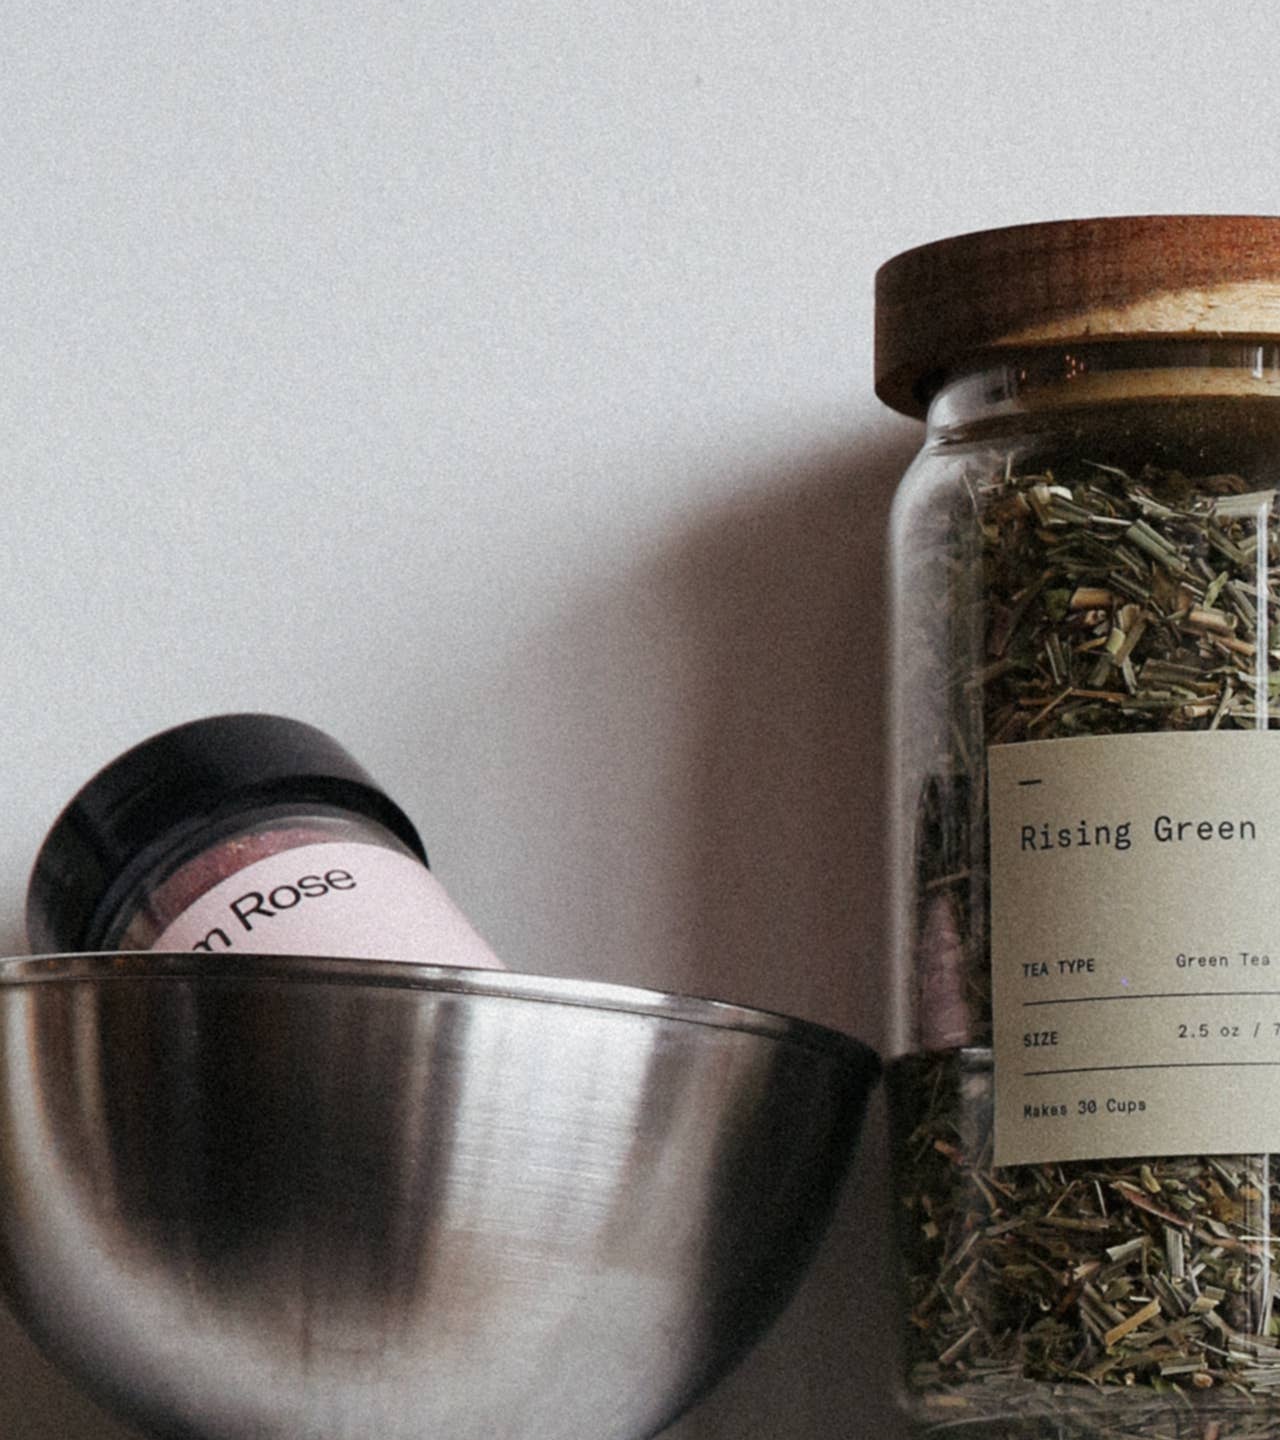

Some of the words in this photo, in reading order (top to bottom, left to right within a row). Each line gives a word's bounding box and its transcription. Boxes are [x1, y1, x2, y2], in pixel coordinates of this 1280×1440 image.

[1020, 820, 1132, 851] Rising
[1153, 815, 1256, 842] Green
[230, 869, 357, 932] Rose
[1022, 962, 1048, 978] TEA
[1057, 958, 1095, 975] TYPE
[1176, 953, 1228, 968] Green
[1239, 952, 1271, 967] Tea
[1023, 1031, 1058, 1048] SIZE
[1178, 1024, 1209, 1039] 2.5
[1220, 1026, 1240, 1038] oz
[1252, 1022, 1261, 1039] /
[1023, 1103, 1067, 1119] Makes
[1077, 1099, 1097, 1115] 30
[1106, 1097, 1146, 1114] Cups
